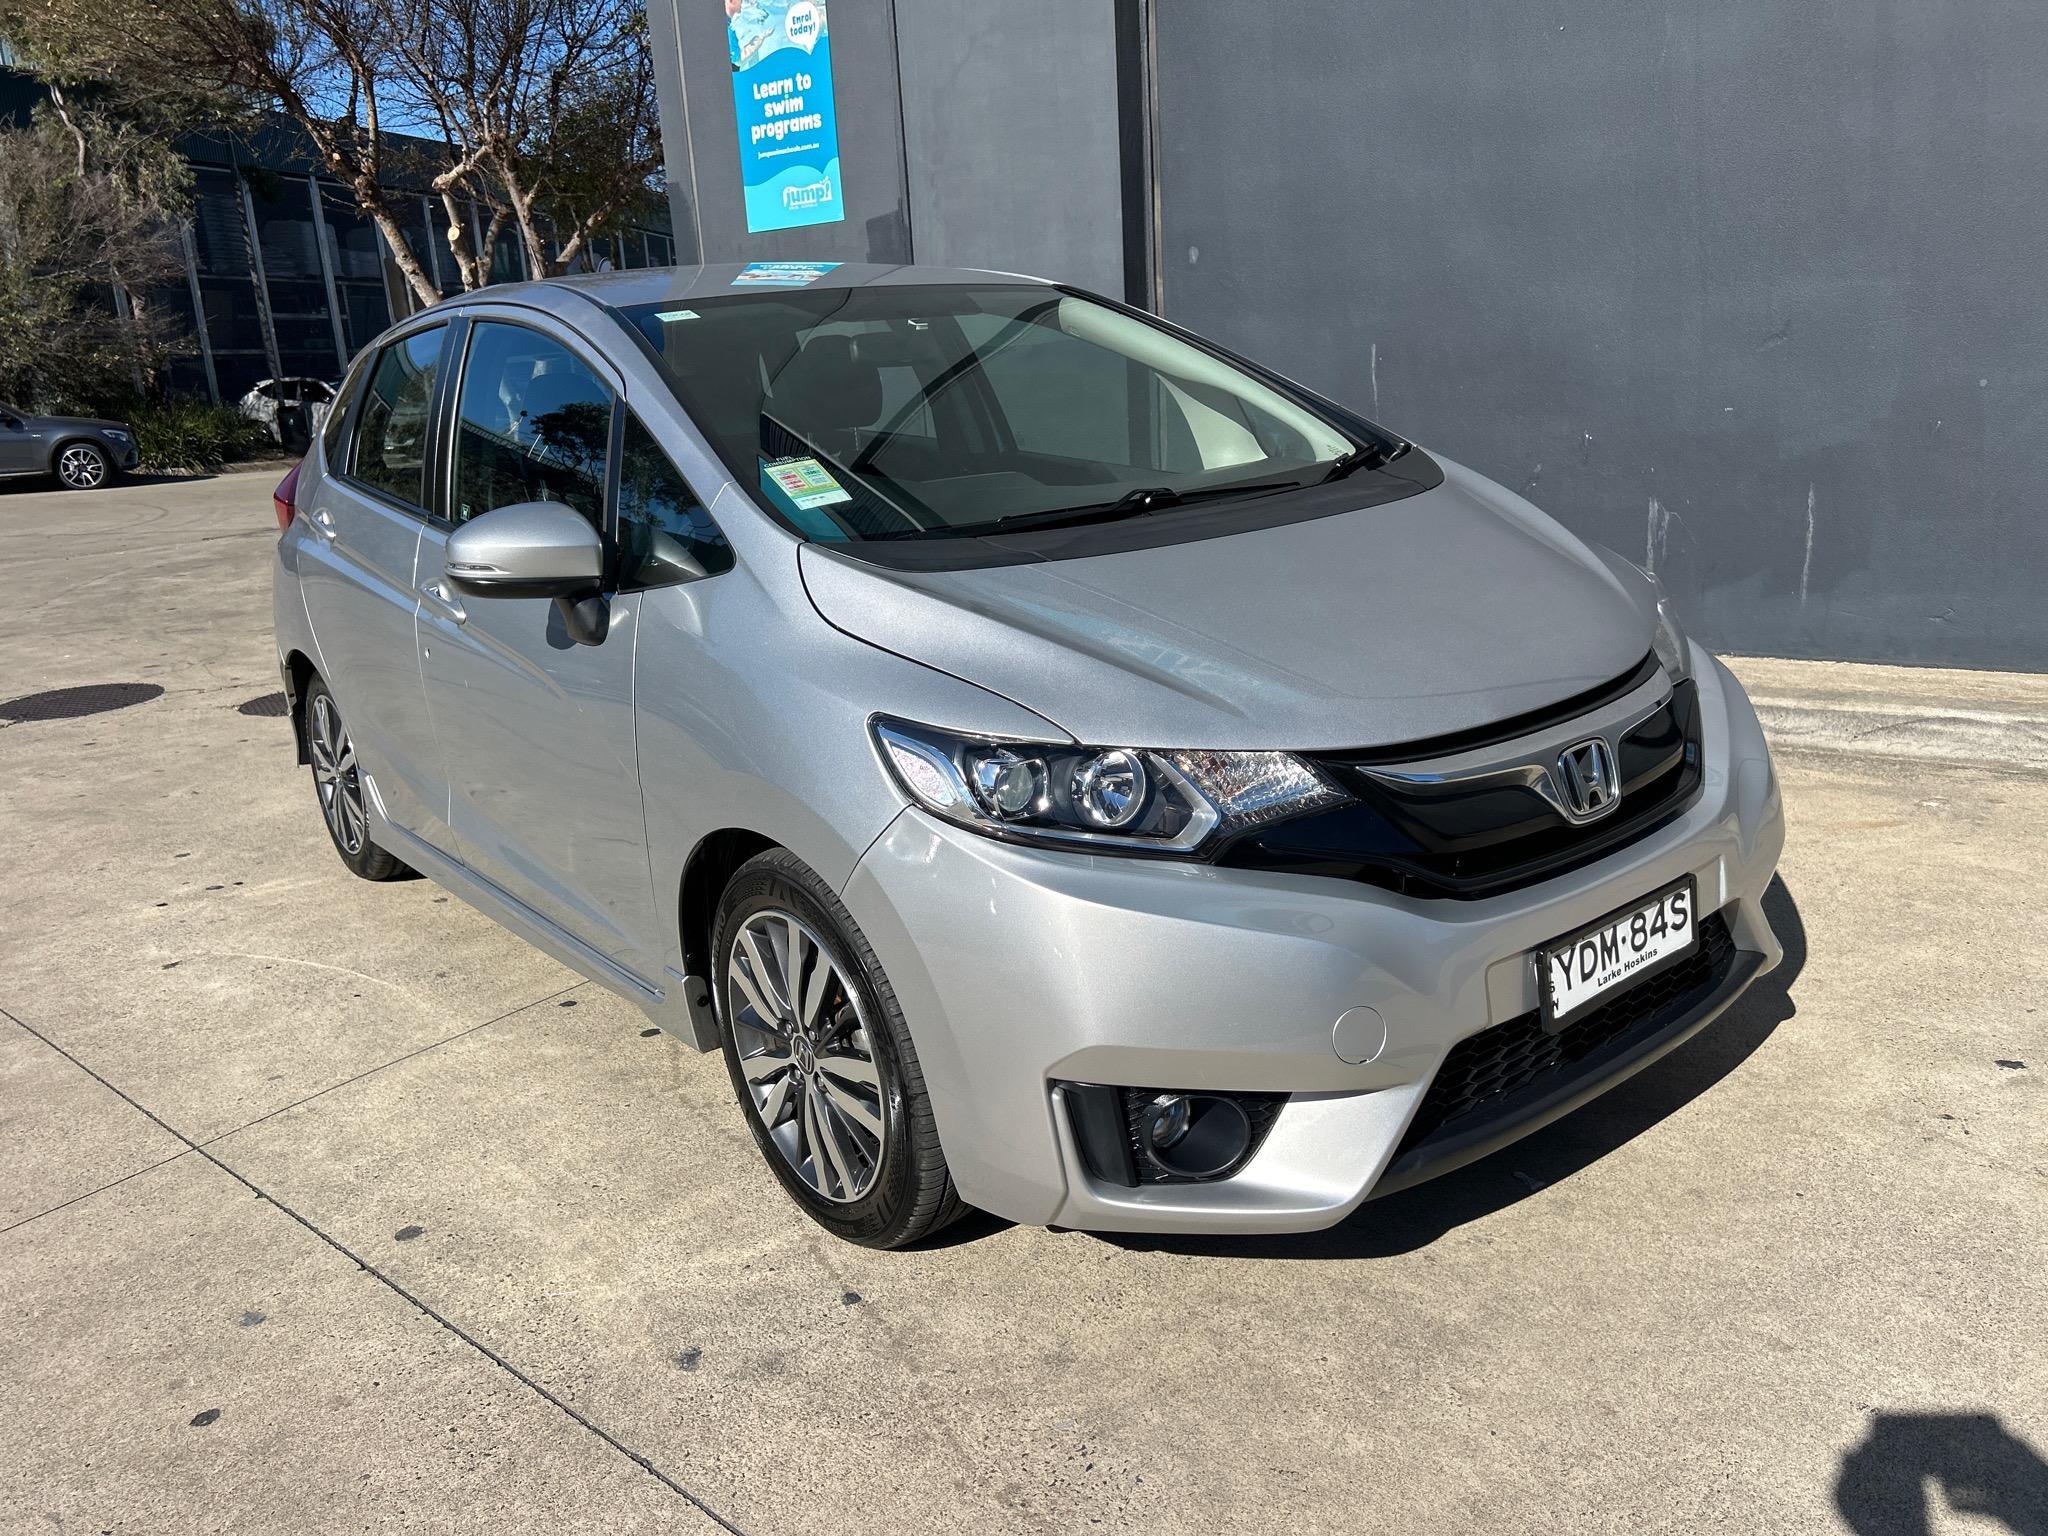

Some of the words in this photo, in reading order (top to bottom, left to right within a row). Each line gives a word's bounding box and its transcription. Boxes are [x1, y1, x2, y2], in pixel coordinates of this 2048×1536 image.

[790, 22, 816, 36] today!
[792, 10, 812, 25] Enrol
[753, 78, 793, 100] Learn
[796, 73, 812, 90] to
[764, 94, 803, 117] swim
[752, 113, 822, 143] programs
[1597, 968, 1622, 987] Larke
[1624, 948, 1658, 972] Hoskins
